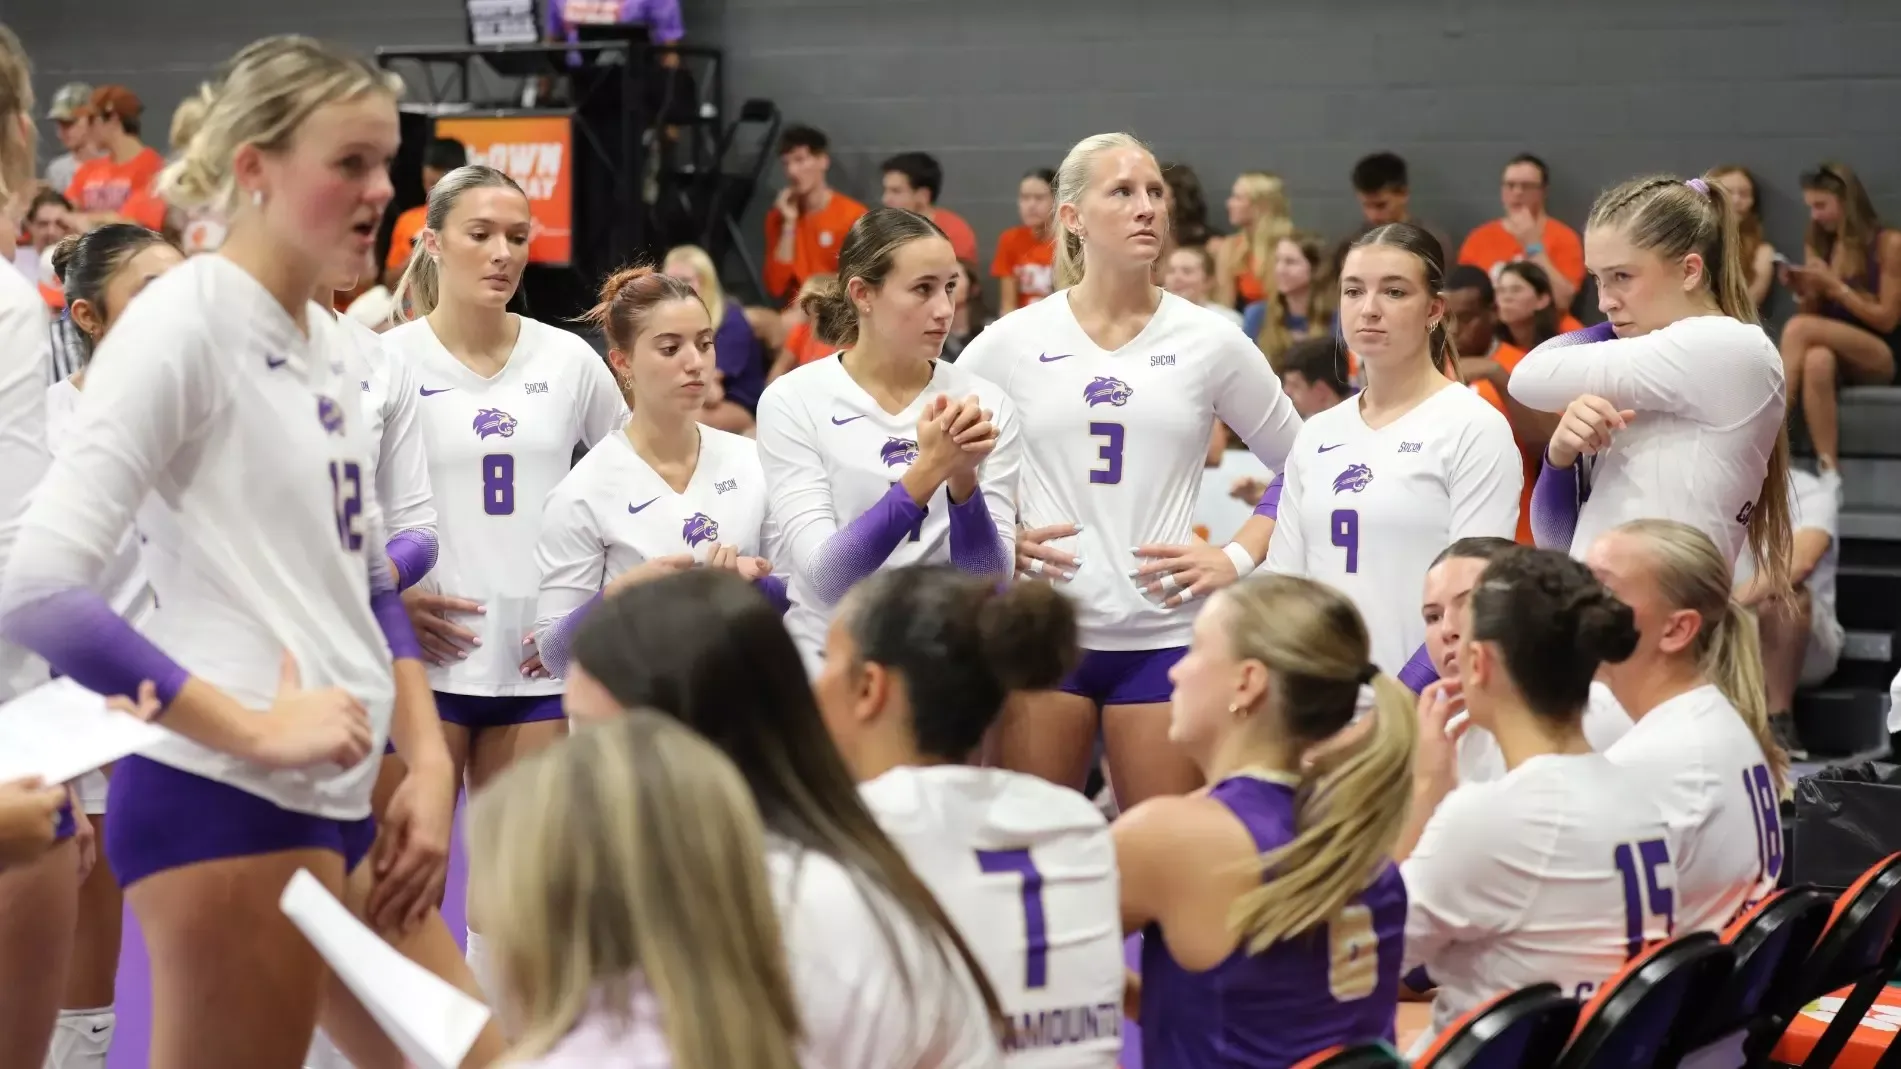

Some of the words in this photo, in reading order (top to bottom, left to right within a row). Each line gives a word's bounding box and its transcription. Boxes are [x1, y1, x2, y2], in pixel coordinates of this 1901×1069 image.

[481, 453, 516, 517] 8
[1088, 420, 1126, 486] 3
[328, 460, 363, 552] 12
[1330, 508, 1359, 575] 9
[1742, 763, 1784, 882] 18
[973, 847, 1048, 990] 7
[1614, 837, 1675, 962] 15
